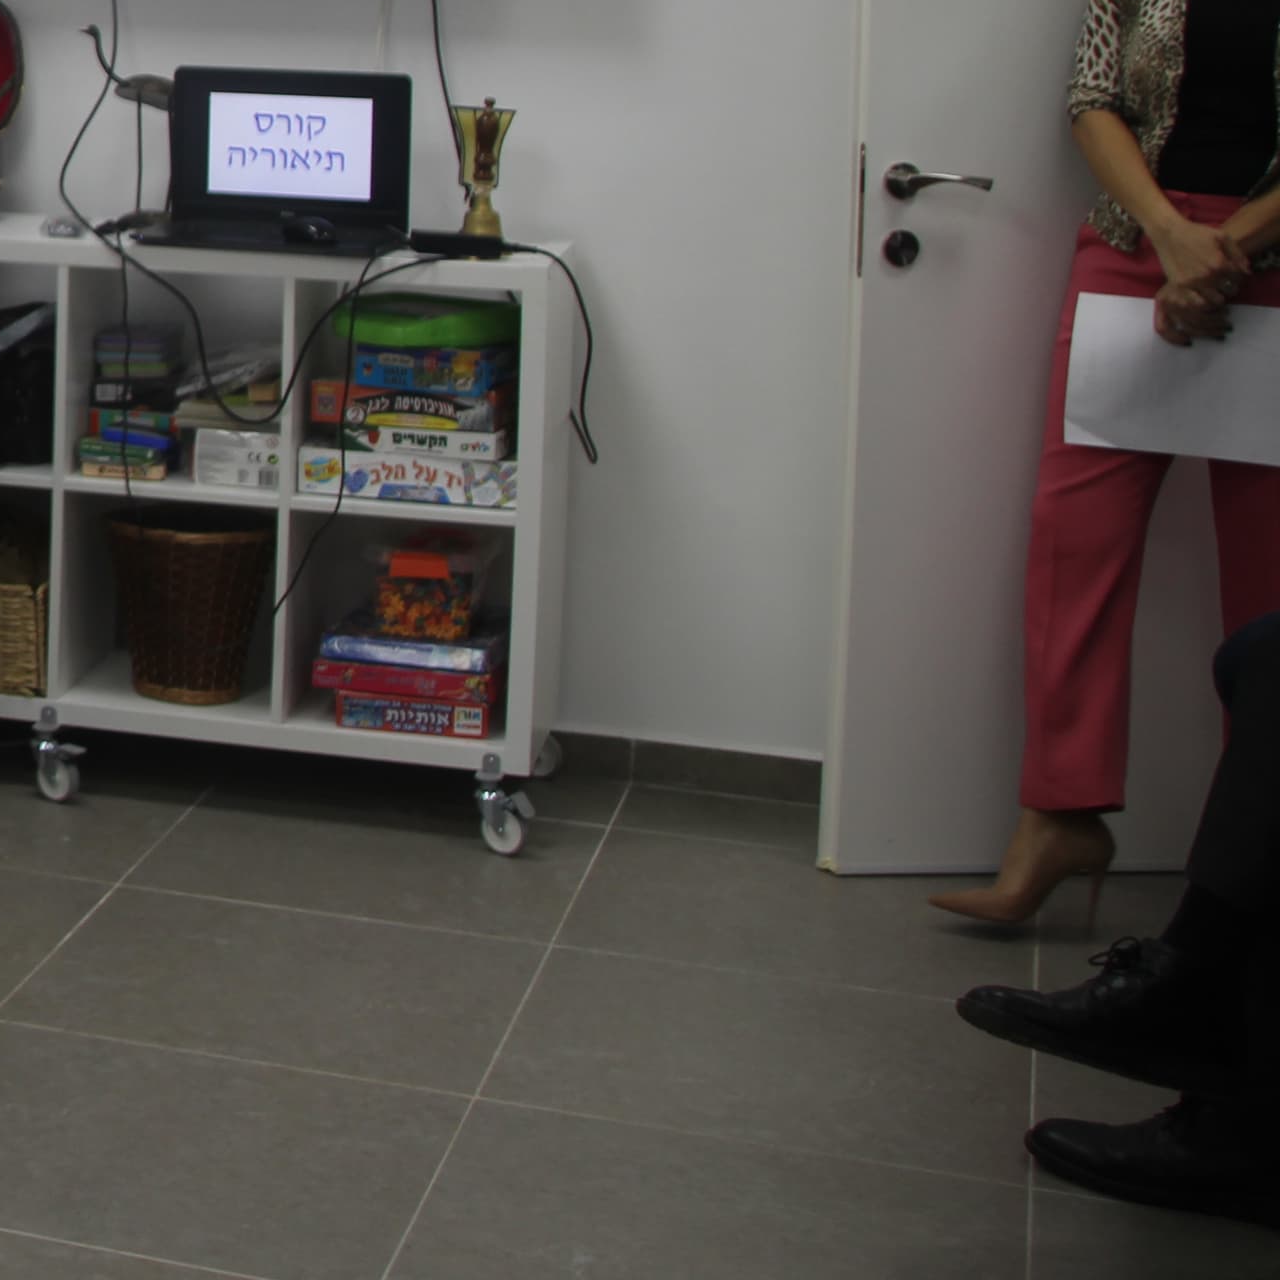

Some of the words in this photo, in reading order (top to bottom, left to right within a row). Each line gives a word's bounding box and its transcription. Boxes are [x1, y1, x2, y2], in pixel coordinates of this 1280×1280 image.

[253, 111, 327, 141] קורס
[228, 145, 346, 173] תיאוריה
[412, 459, 438, 485] על
